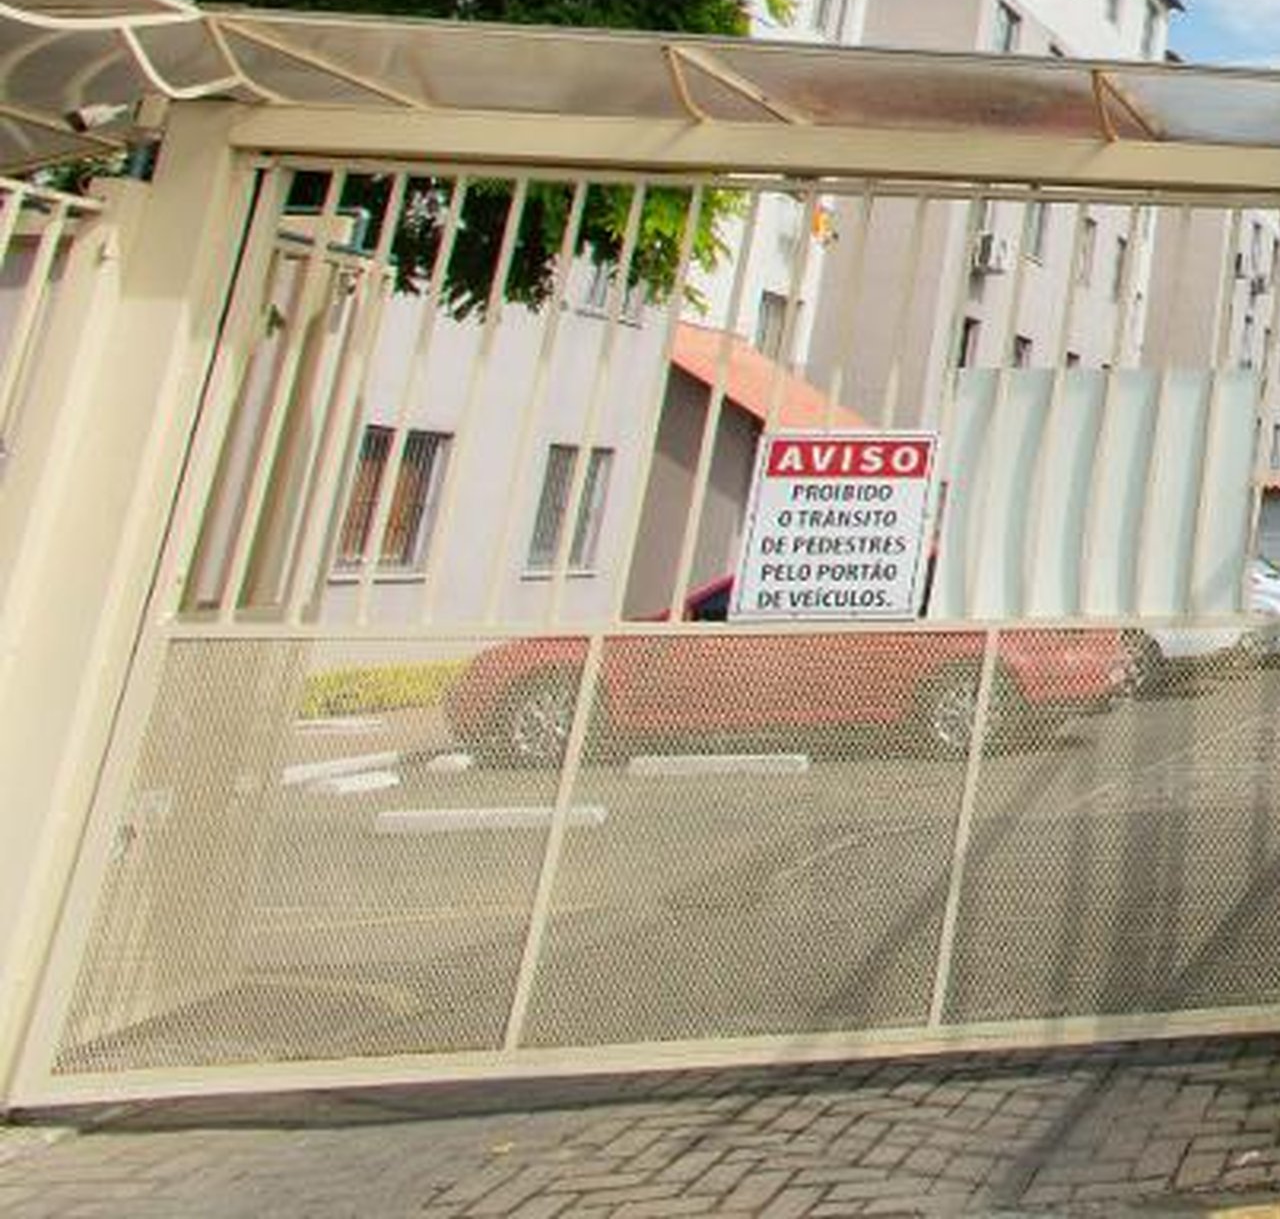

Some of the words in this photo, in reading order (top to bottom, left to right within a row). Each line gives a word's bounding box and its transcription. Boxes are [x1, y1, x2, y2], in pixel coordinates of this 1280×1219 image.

[778, 445, 919, 472] AVISO
[792, 484, 893, 502] PROIBIDO
[777, 509, 792, 528] O
[760, 536, 788, 555] DE
[793, 536, 907, 555] PEDESTRES
[760, 563, 811, 581] PELO
[816, 558, 898, 581] PORTÃO
[757, 589, 784, 608] DE
[790, 586, 893, 609] VEÍCULOS.
